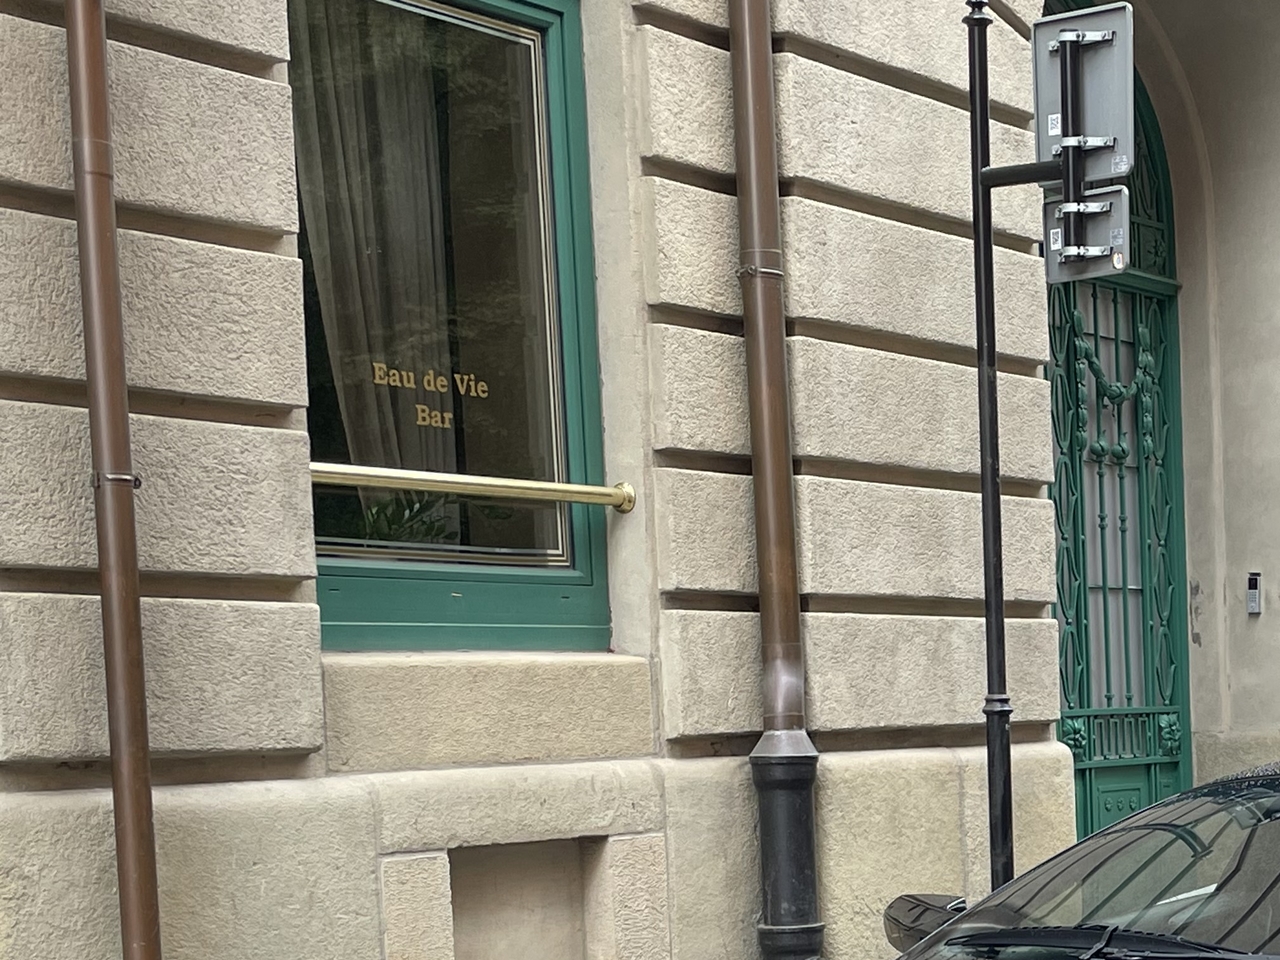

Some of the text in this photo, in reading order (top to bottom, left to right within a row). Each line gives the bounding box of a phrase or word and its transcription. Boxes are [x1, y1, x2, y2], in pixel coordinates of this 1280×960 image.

[372, 362, 489, 398] Eau de Vie
[415, 404, 453, 429] Bar
